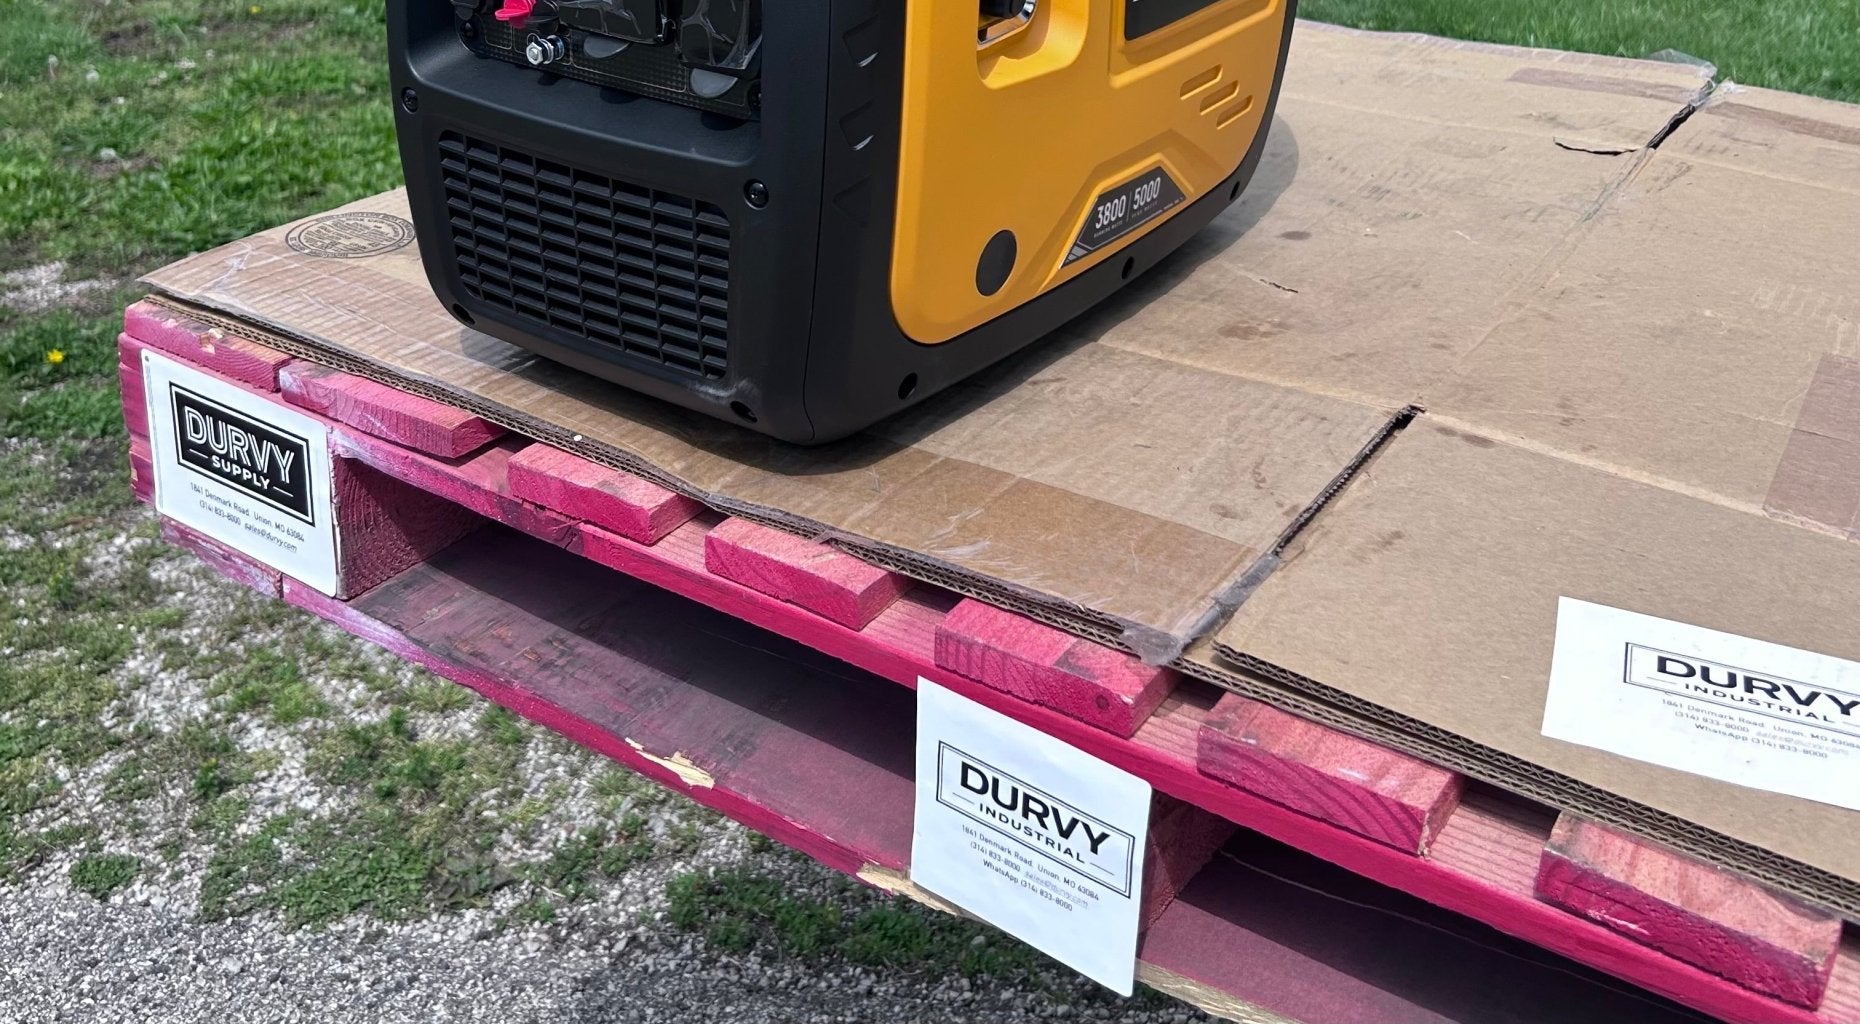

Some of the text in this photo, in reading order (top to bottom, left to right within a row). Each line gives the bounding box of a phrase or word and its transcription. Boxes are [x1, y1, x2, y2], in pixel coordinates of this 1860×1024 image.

[1095, 194, 1127, 229] 3800
[1133, 177, 1161, 210] 5000
[184, 405, 295, 484] DURVY
[211, 455, 270, 490] SUPPLY
[205, 488, 232, 508] Denmark
[1657, 655, 1860, 716] DURVY
[1684, 682, 1836, 723] INDUSTRIAL
[1687, 704, 1735, 722] Denmark
[1694, 723, 1749, 743] WhatsApp
[960, 760, 1111, 855] DURVY
[979, 802, 1085, 864] INDUSTRIAL
[979, 831, 1012, 855] Denmark
[982, 858, 1019, 884] WhatsApp
